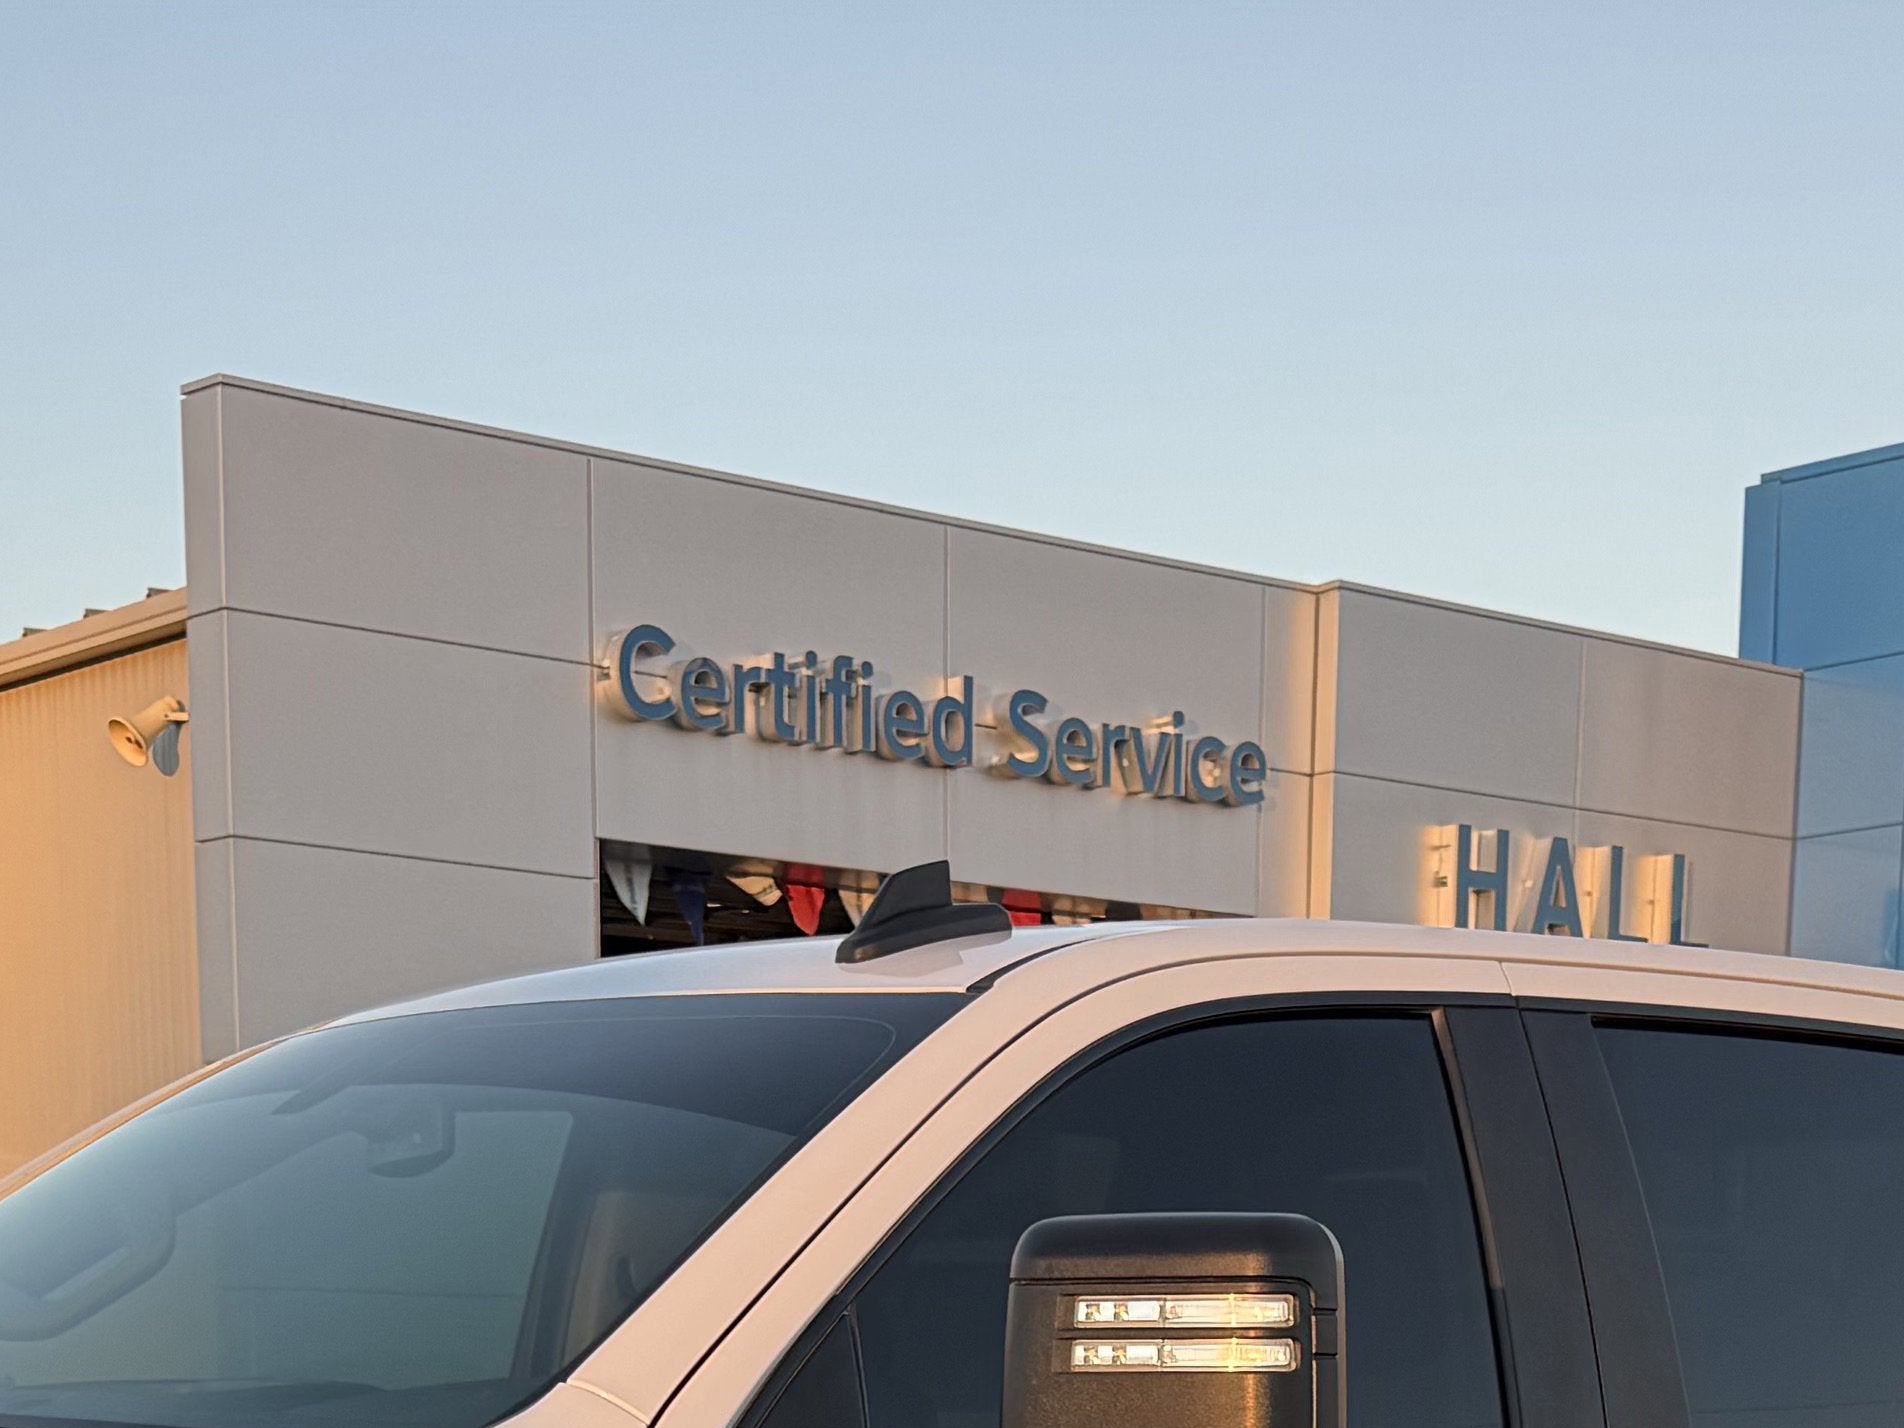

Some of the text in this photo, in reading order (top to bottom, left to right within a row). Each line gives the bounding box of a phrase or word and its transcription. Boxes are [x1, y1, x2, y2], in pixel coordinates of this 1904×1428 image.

[610, 624, 1268, 806] Certified Service
[1451, 823, 1710, 948] HALL
